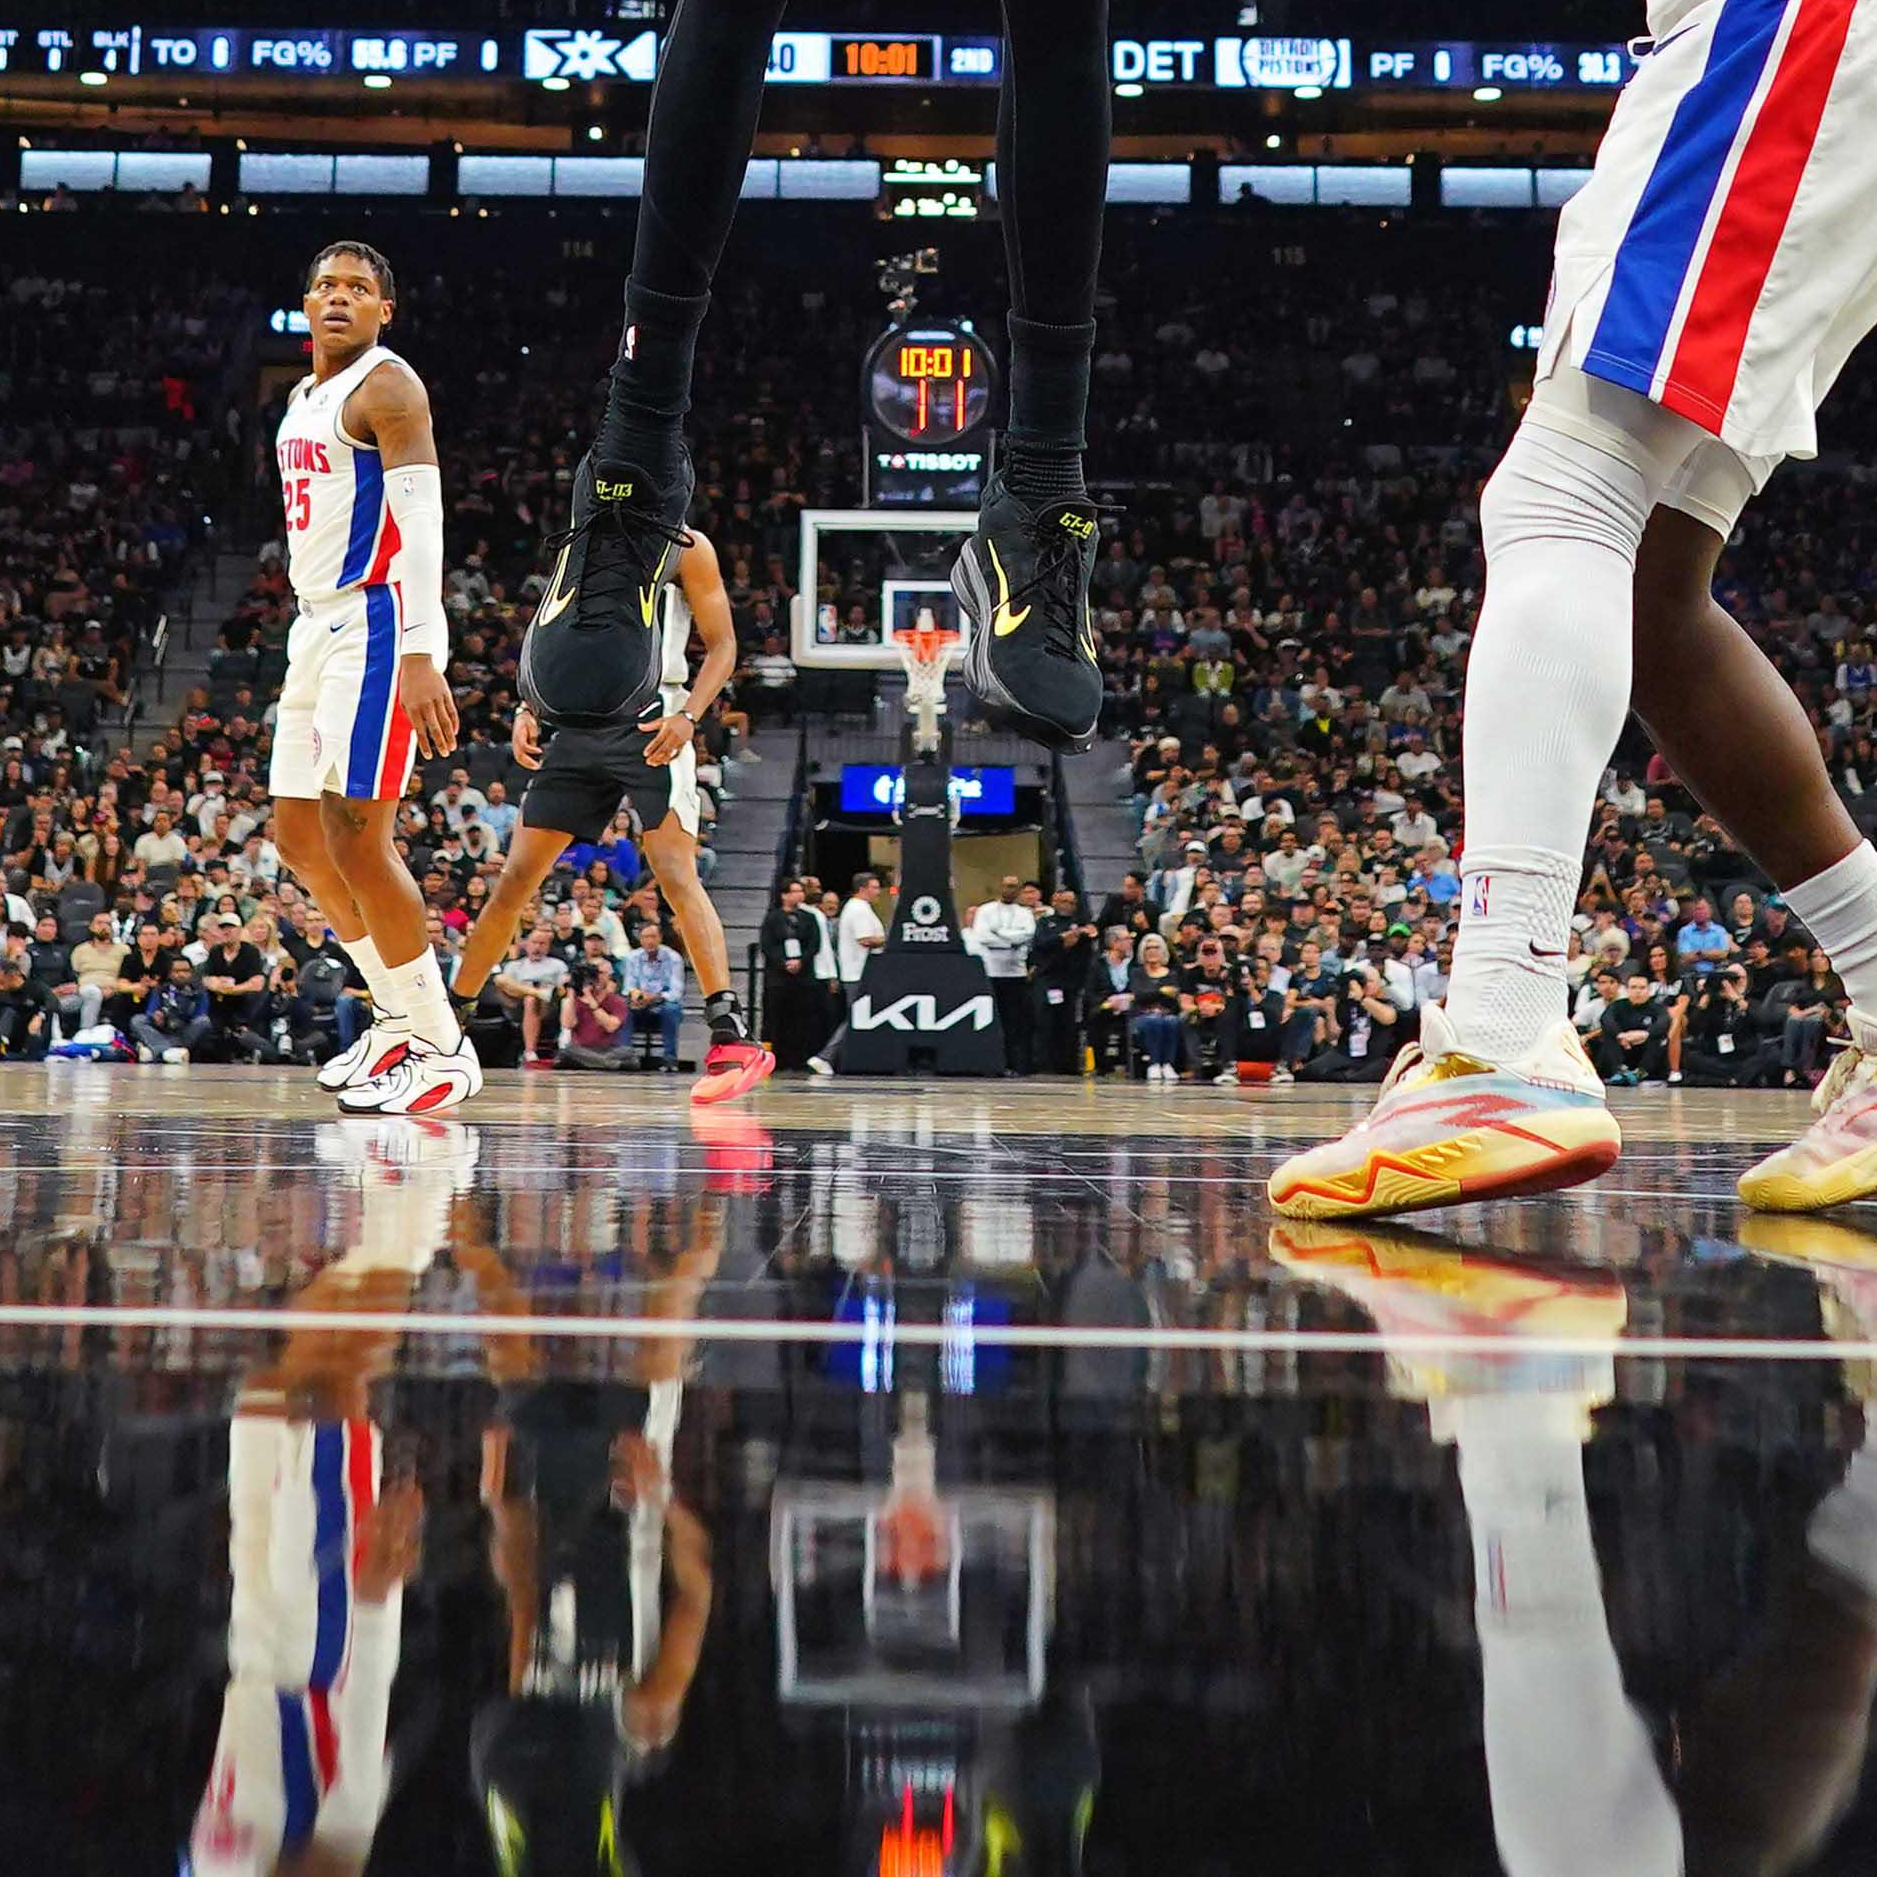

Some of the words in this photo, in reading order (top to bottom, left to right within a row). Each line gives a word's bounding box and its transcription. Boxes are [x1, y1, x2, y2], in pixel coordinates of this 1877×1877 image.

[151, 37, 198, 66] TO
[251, 39, 333, 68] FG%
[413, 41, 459, 68] PF
[845, 42, 918, 76] 10:01
[1113, 40, 1205, 82] DET
[1369, 52, 1415, 80] PF
[1482, 52, 1564, 82] FG%
[900, 347, 971, 378] 10:01
[917, 378, 966, 432] 11
[906, 452, 982, 471] TISSOT
[283, 477, 312, 532] 25
[901, 921, 951, 943] Frost
[850, 994, 995, 1031] KIA
